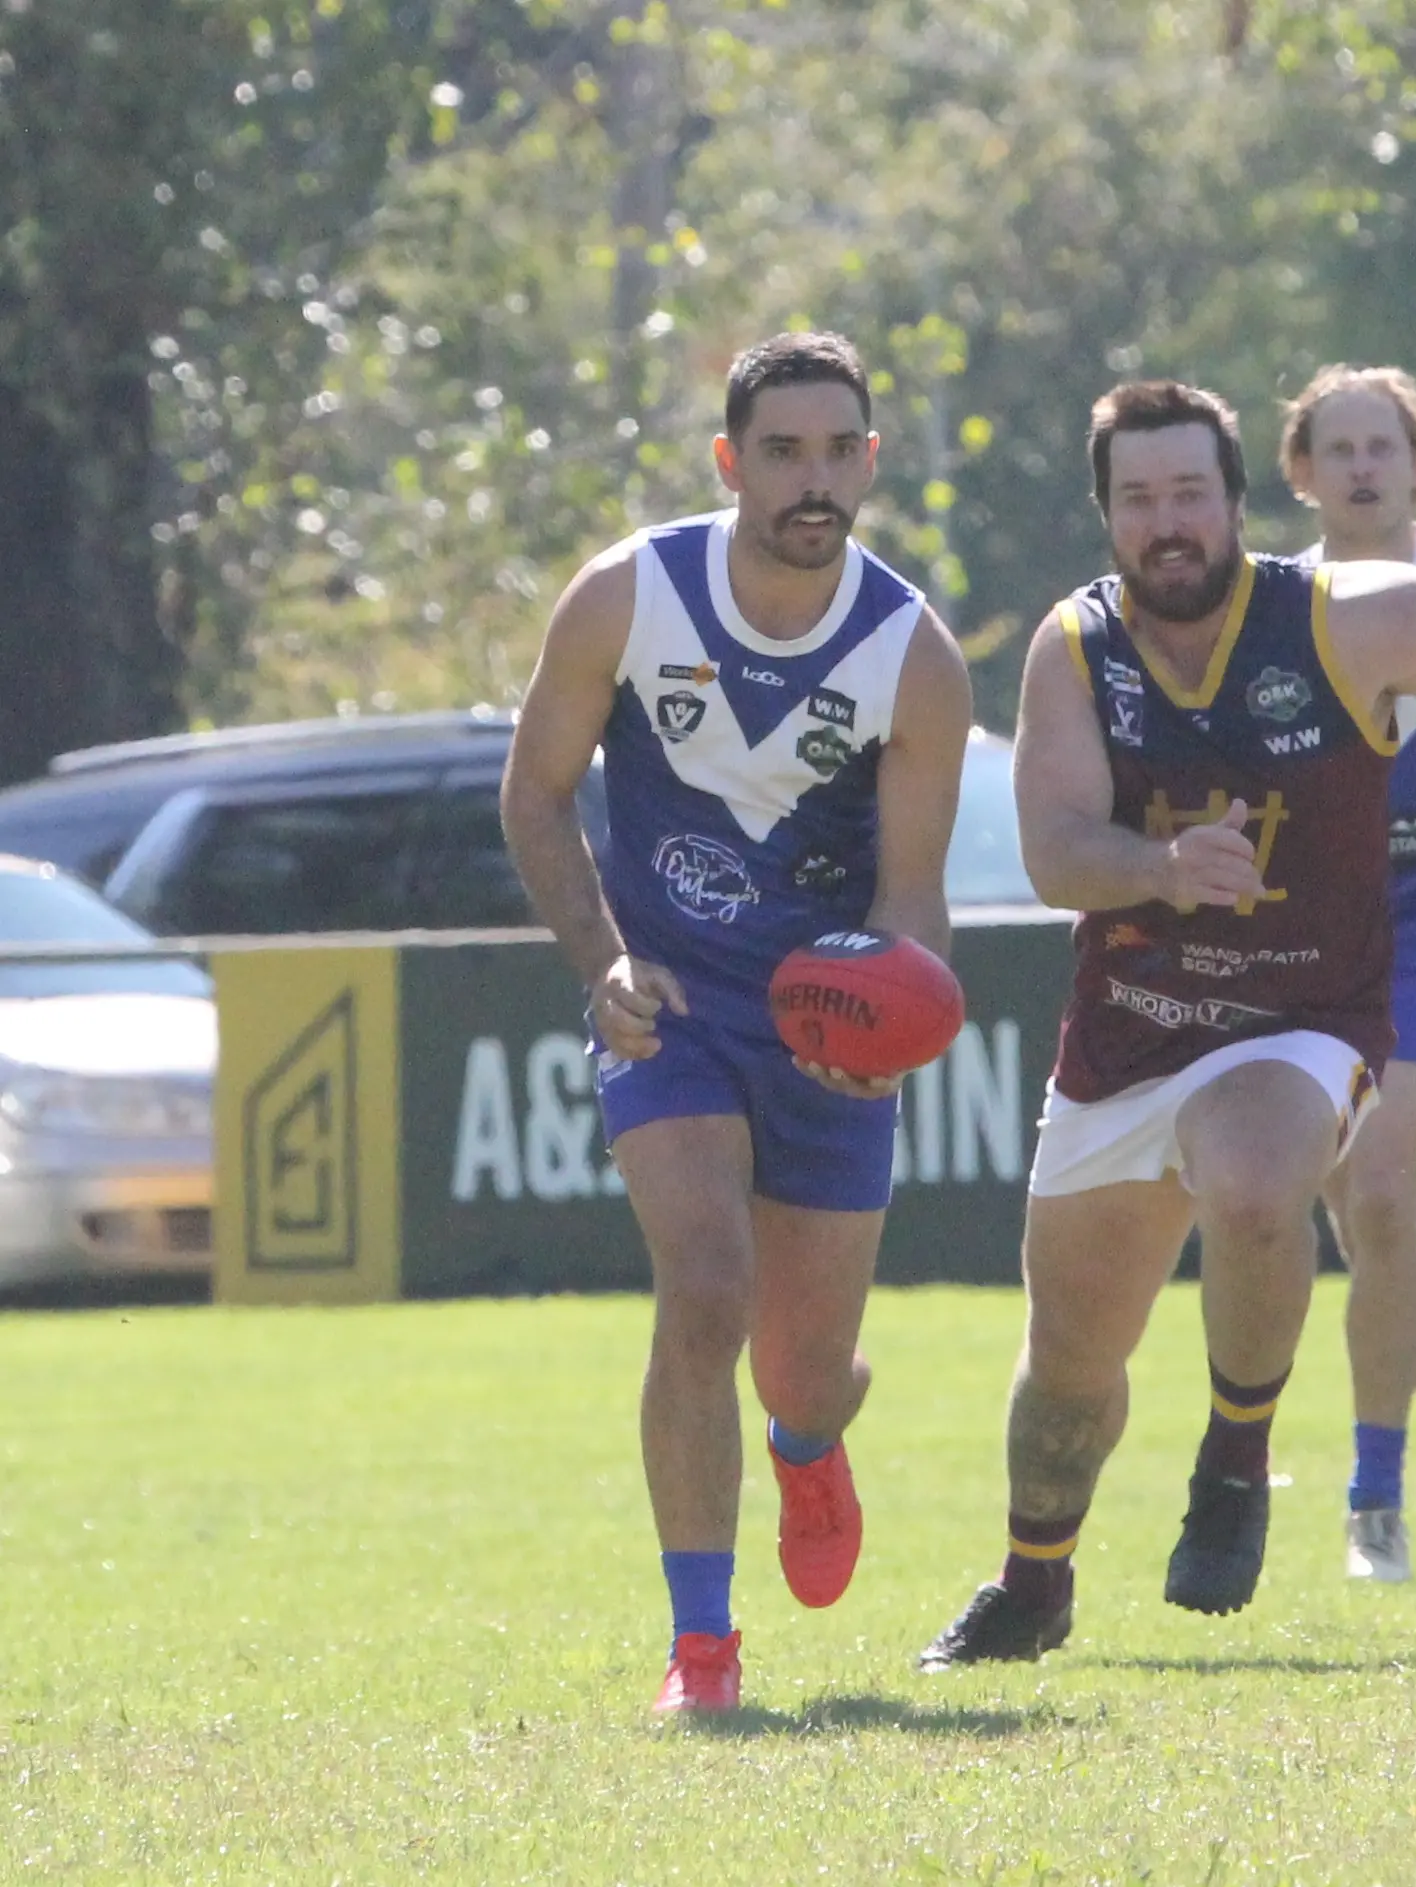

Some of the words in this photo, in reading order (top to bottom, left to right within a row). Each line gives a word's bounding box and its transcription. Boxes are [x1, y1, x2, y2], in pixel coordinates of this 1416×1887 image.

[1182, 943, 1320, 965] WANGARATTA
[776, 983, 879, 1032] HERRIN
[452, 1031, 628, 1203] A&
[892, 1018, 1026, 1185] IN
